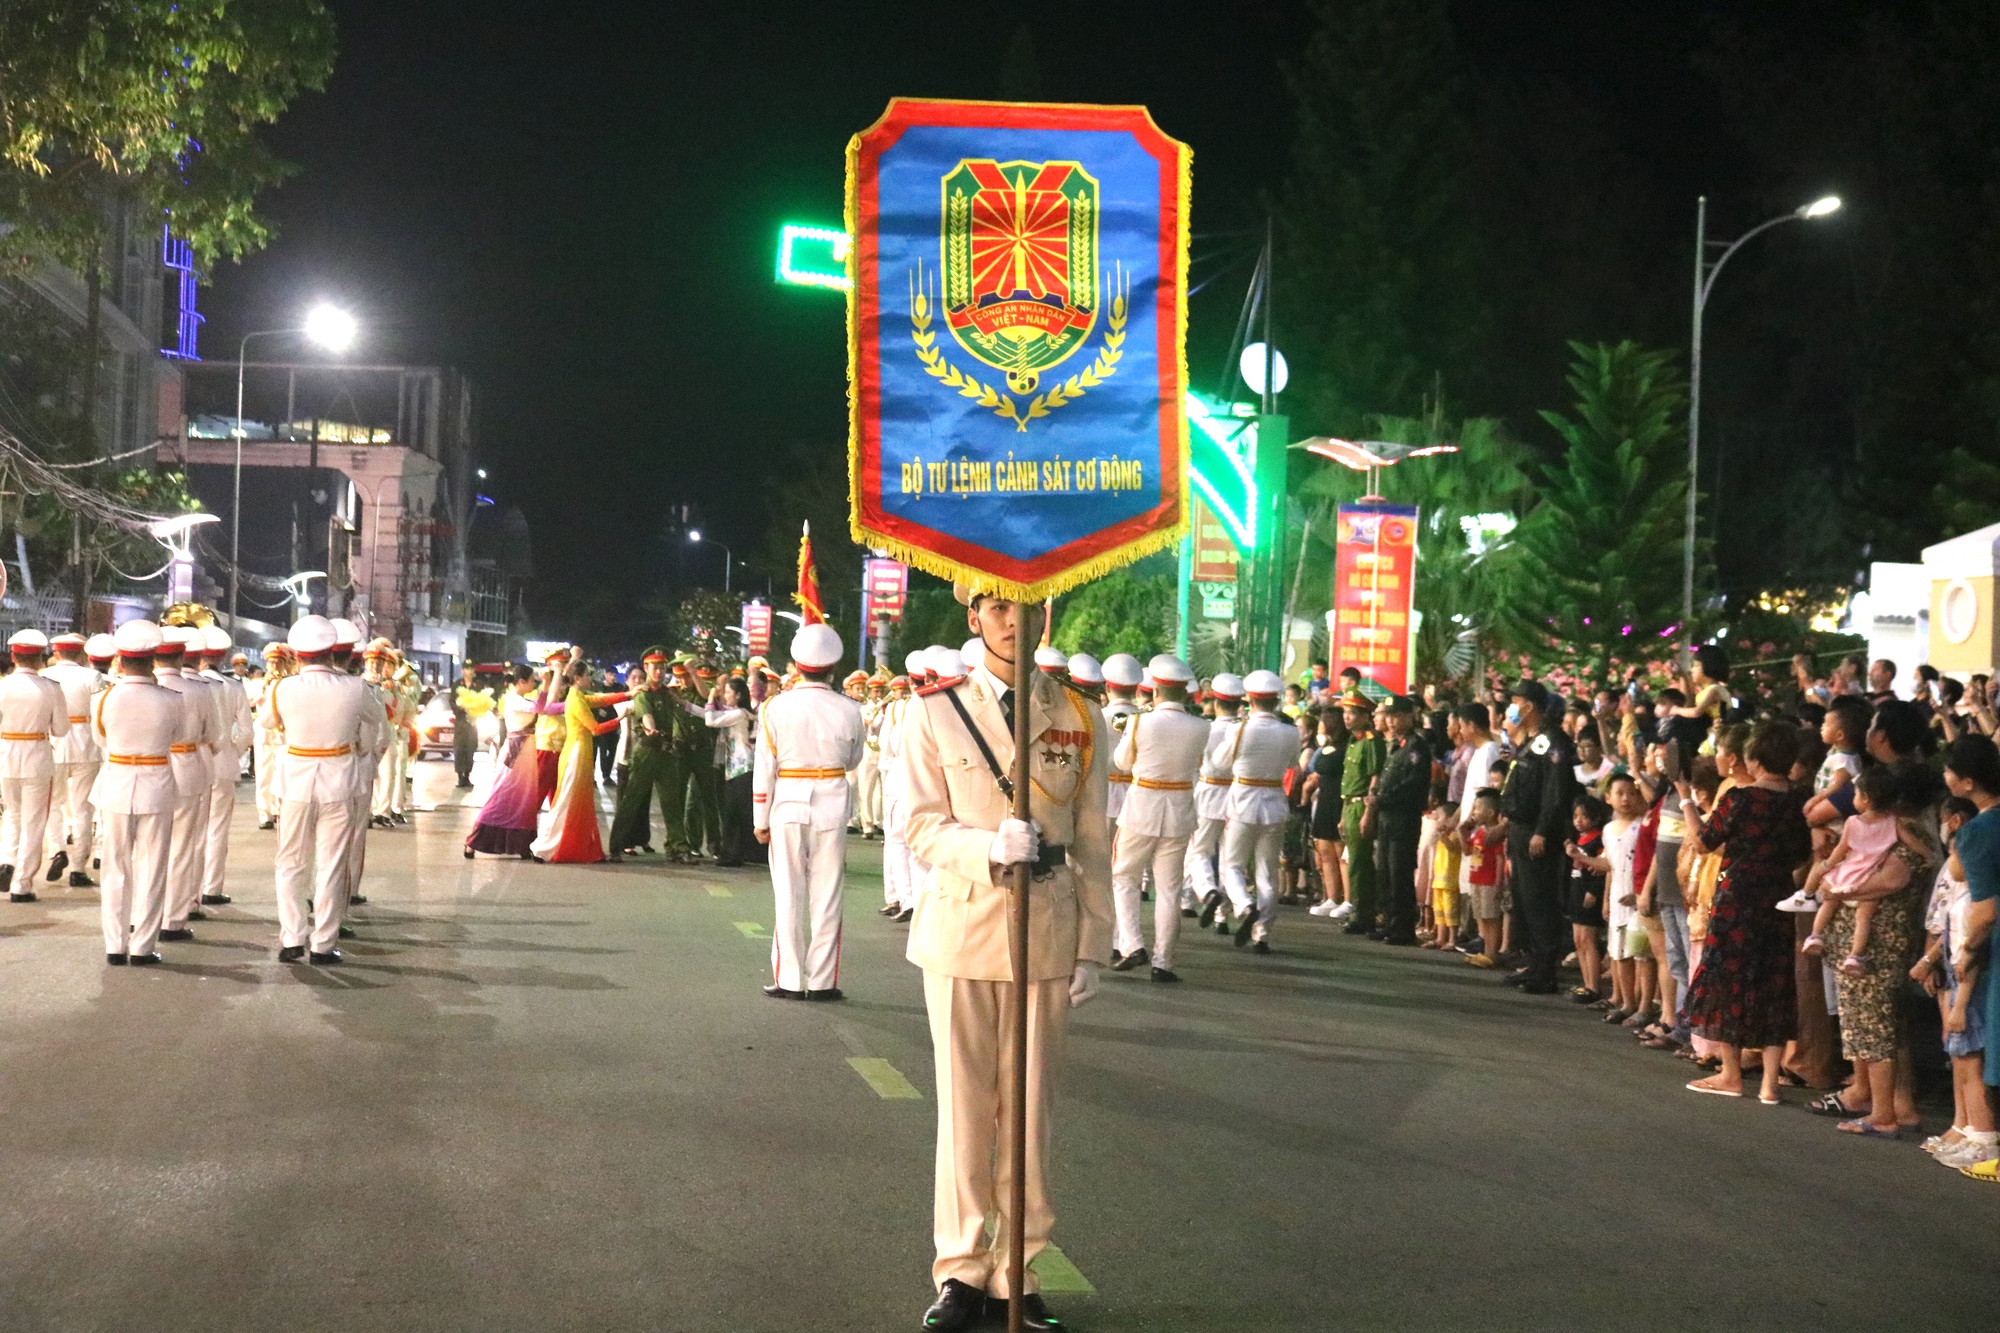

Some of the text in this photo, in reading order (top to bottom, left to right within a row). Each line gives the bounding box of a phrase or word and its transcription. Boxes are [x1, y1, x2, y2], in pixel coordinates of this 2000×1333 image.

[975, 304, 1065, 322] CÔNG AN NHÂN DÂN
[1026, 314, 1049, 327] NAM
[901, 451, 1142, 500] BỘ TƯ LỆNH CẢNH SÁT CƠ ĐỘNG
